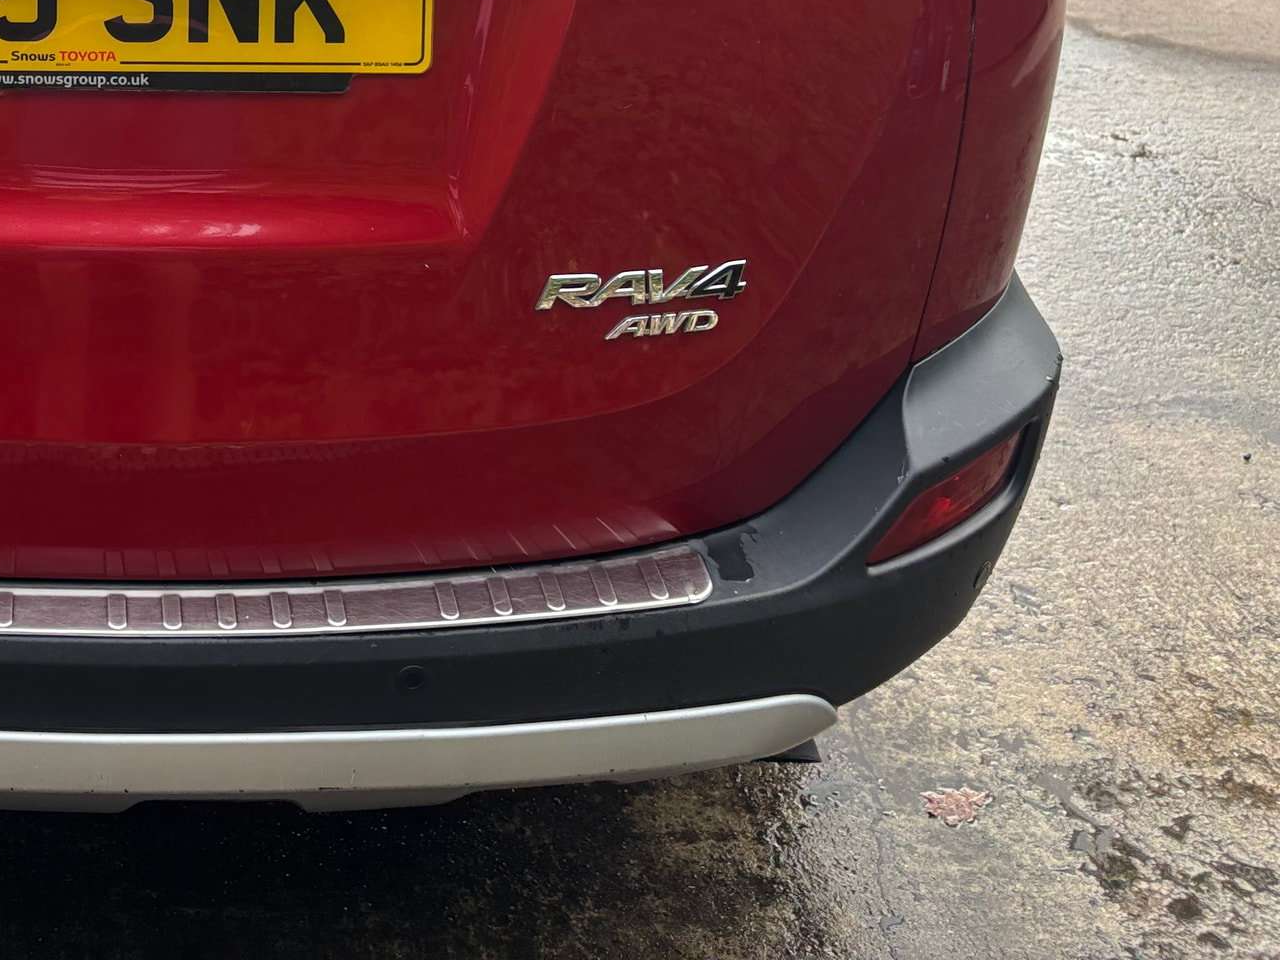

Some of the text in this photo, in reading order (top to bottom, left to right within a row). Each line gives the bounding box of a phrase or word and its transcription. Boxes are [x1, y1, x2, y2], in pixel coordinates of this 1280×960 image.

[11, 50, 117, 62] Snows TOYOTA
[535, 259, 747, 310] RAV4
[605, 309, 719, 340] AWD
